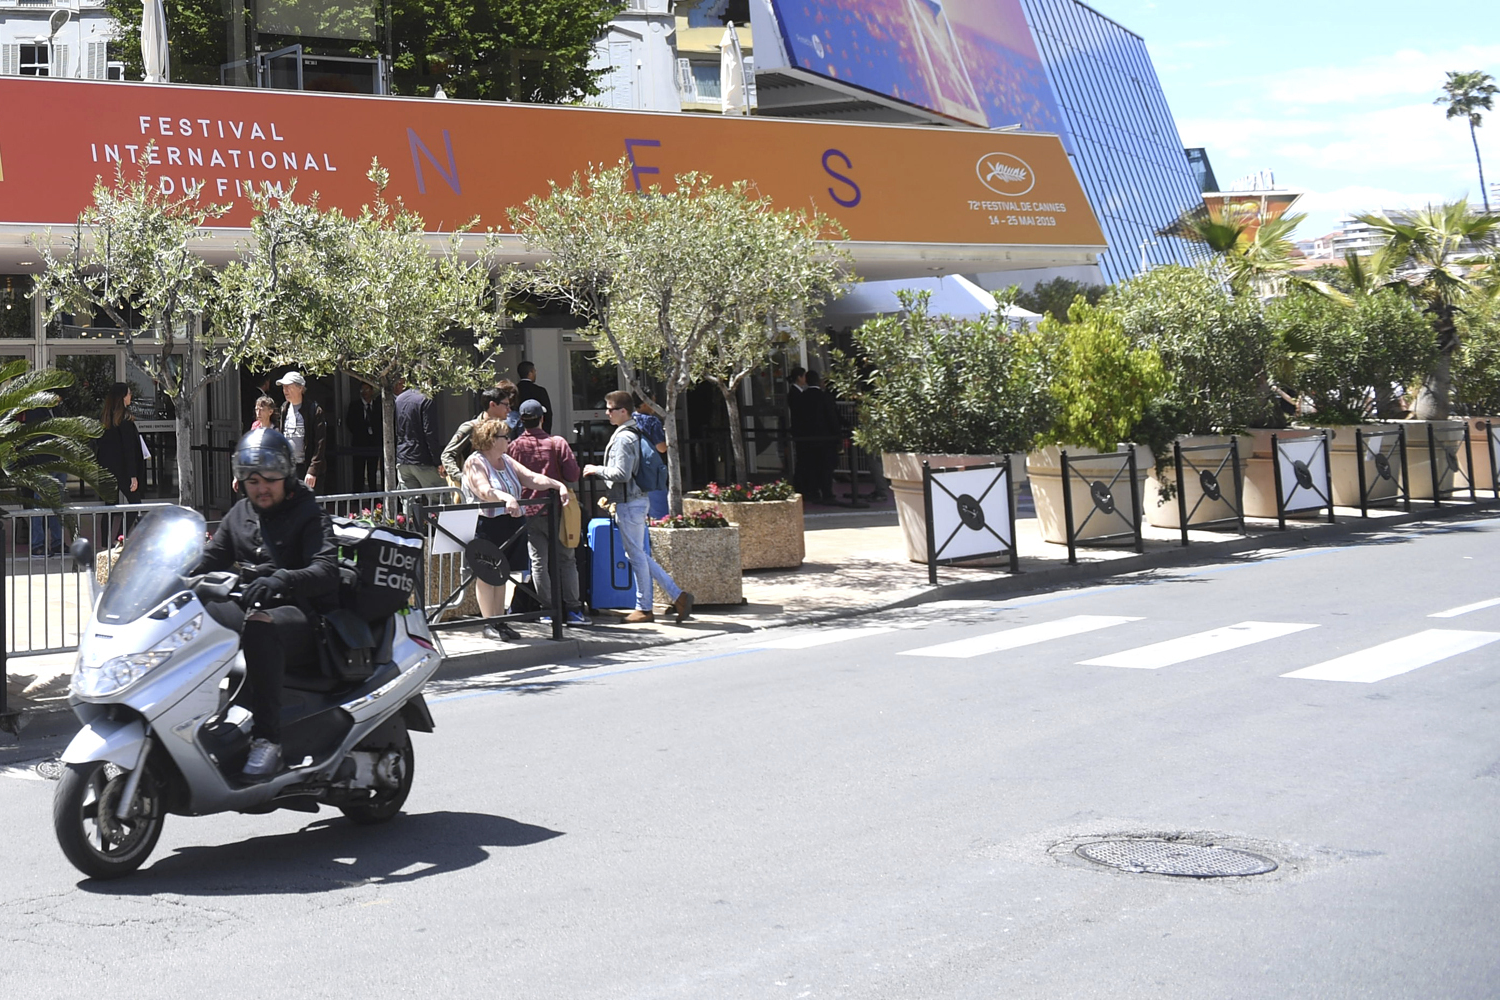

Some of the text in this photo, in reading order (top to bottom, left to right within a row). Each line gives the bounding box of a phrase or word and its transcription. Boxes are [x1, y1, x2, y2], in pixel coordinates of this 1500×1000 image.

[139, 116, 284, 141] FESTIVAL
[91, 143, 337, 171] INTERNATIONAL
[161, 176, 284, 199] DU FILM
[982, 201, 1020, 211] FESTIVAL
[1020, 202, 1032, 211] DE
[1033, 202, 1066, 212] CANNES
[988, 215, 999, 225] 14
[1007, 215, 1018, 225] 25
[1019, 216, 1035, 226] MAI
[1035, 216, 1056, 226] 2019
[379, 546, 416, 570] Uber
[374, 566, 414, 592] Eats
